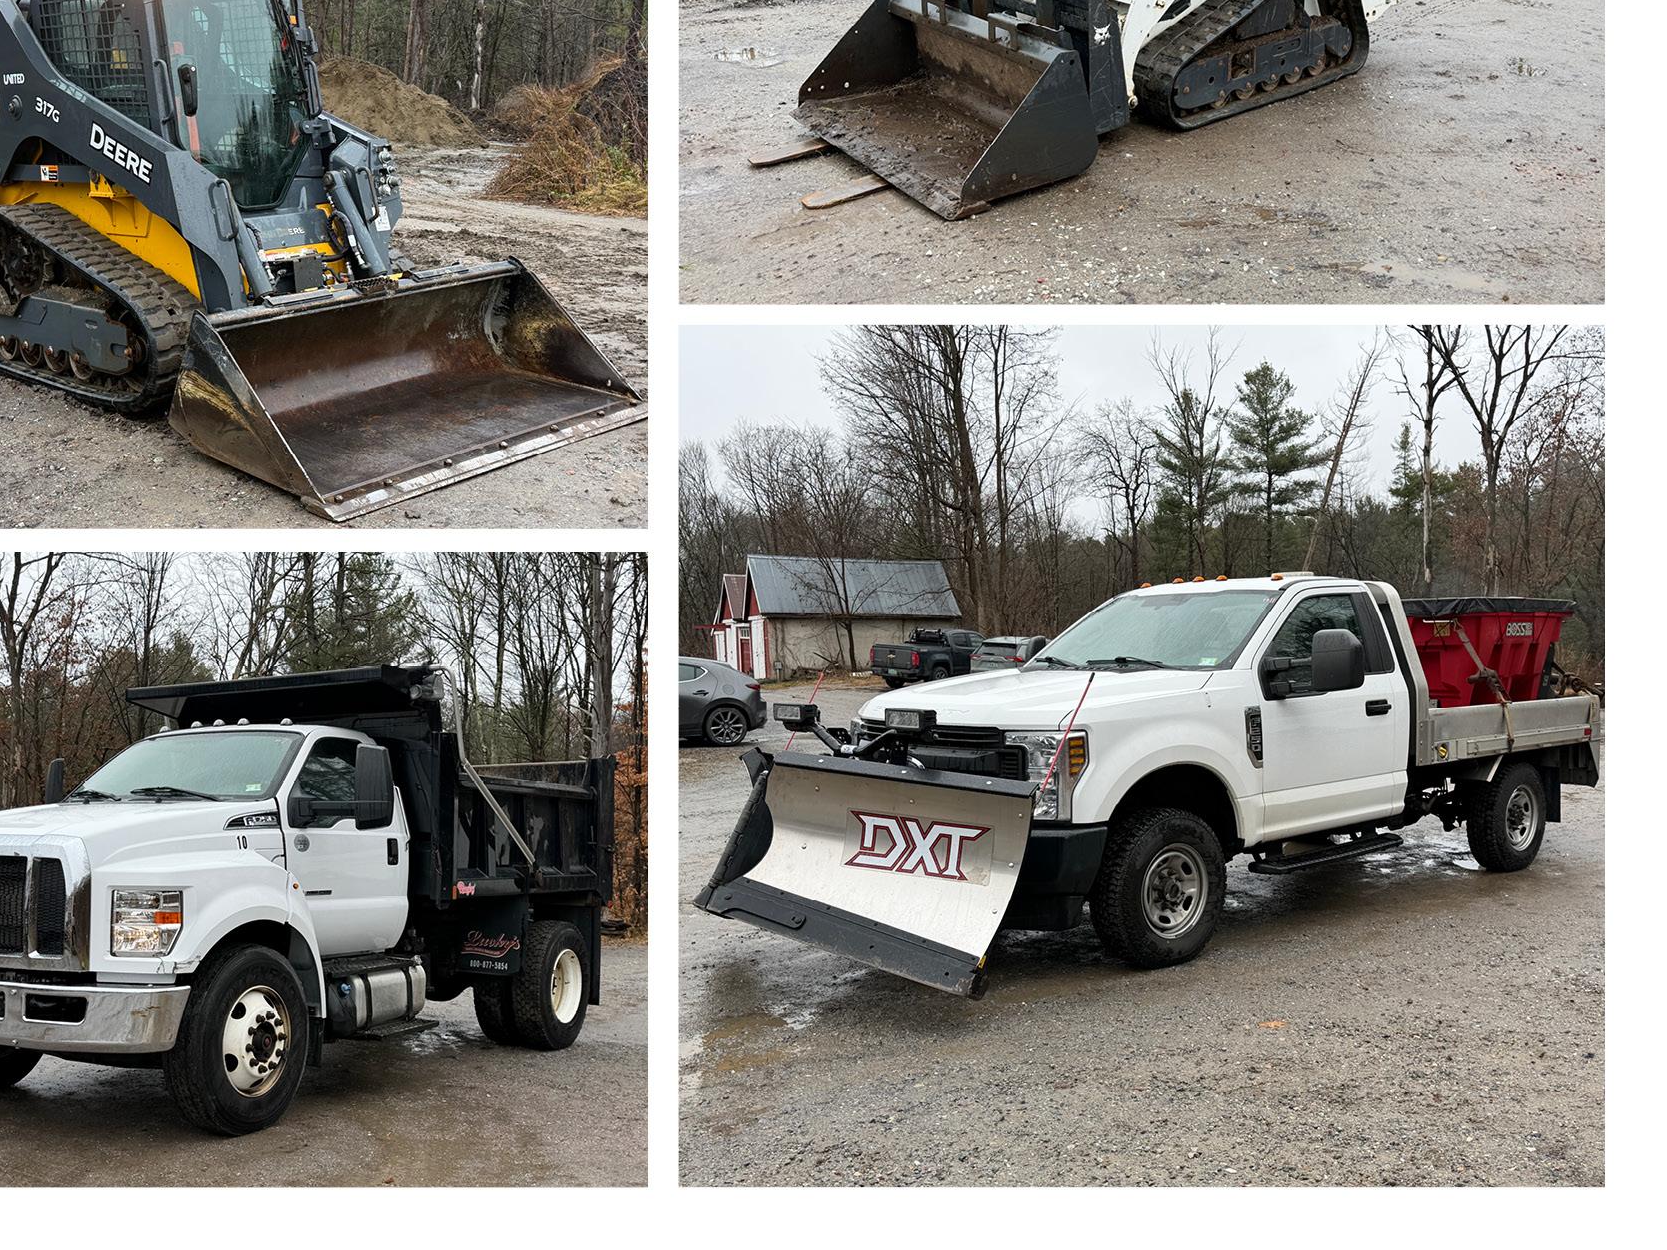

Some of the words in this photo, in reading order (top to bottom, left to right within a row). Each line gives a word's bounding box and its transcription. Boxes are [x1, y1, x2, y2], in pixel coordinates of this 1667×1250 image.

[3, 73, 25, 85] UNITED
[34, 96, 61, 123] 317G
[89, 122, 154, 184] DEERE
[1506, 621, 1525, 636] BOSS
[237, 835, 248, 850] 10
[844, 810, 992, 881] DXT
